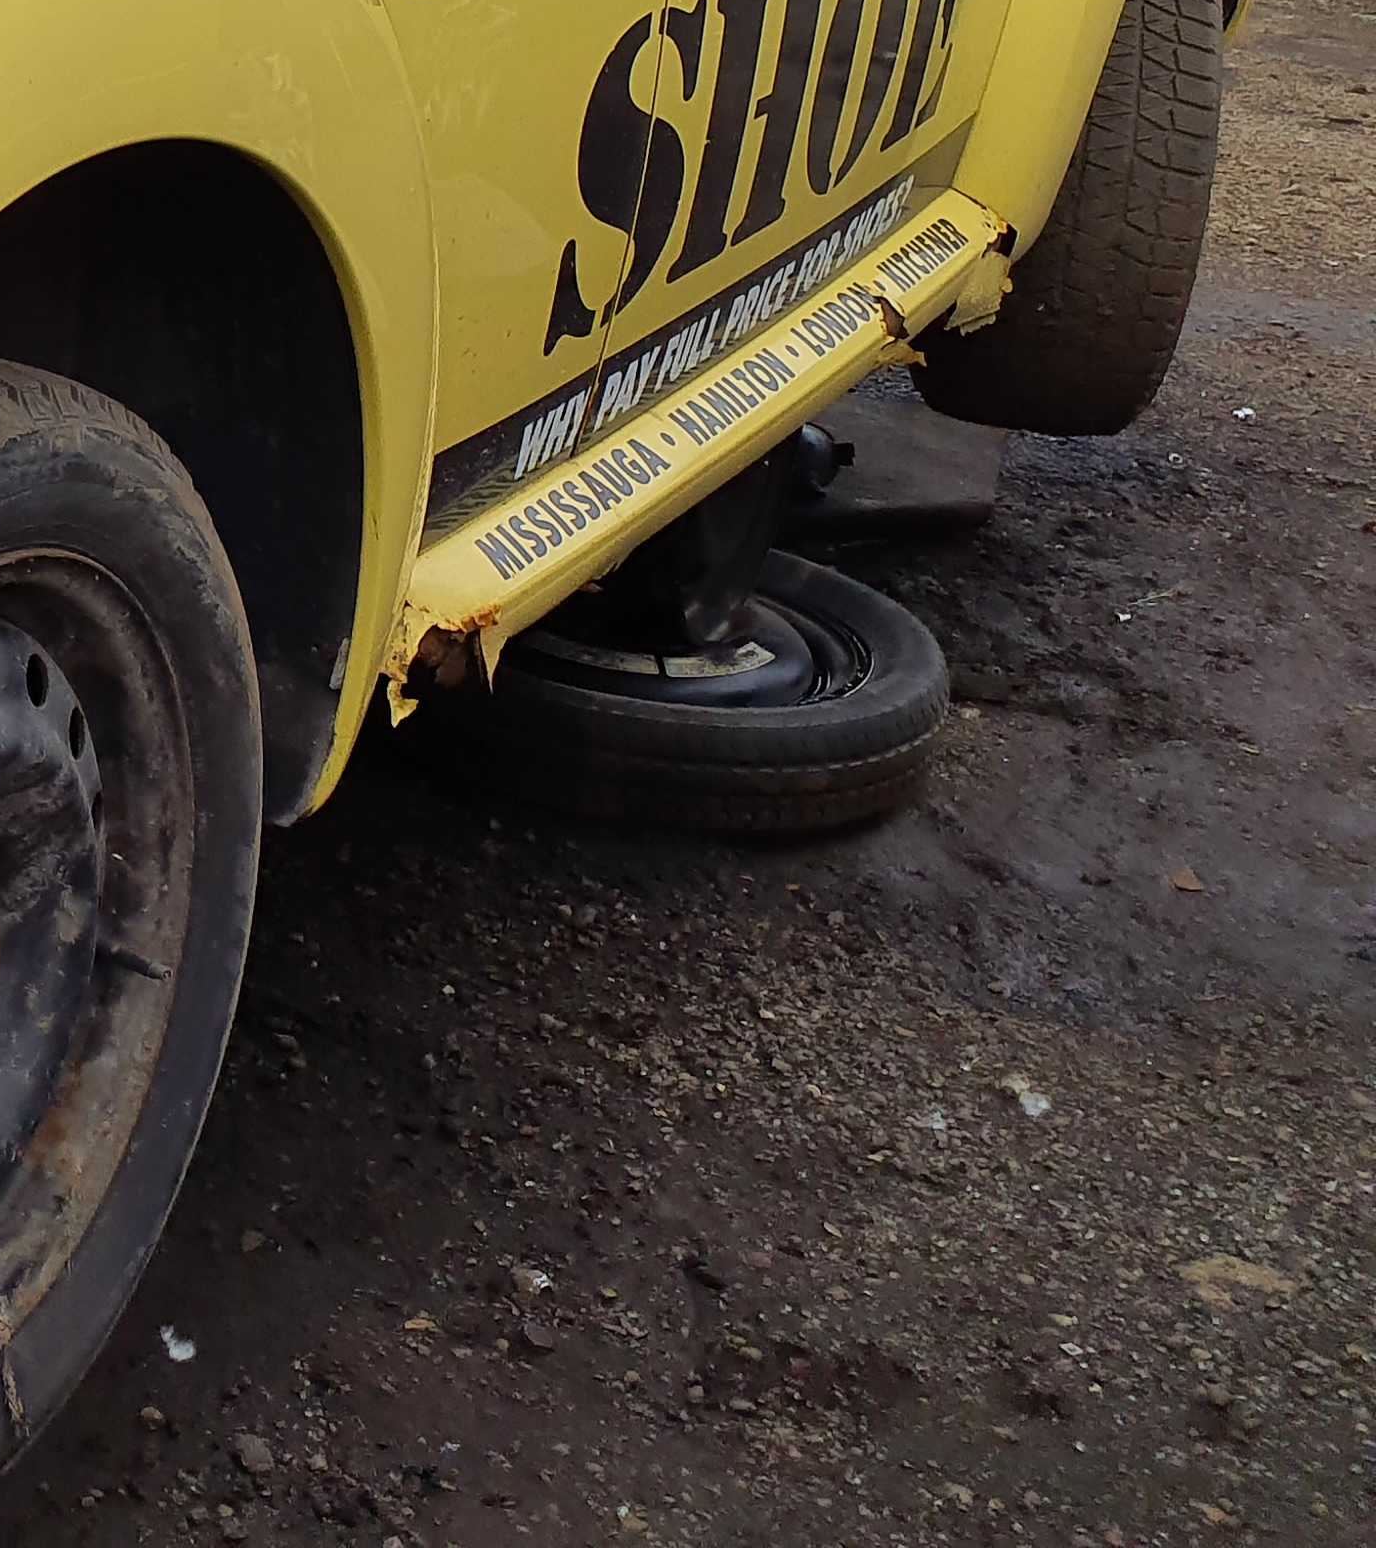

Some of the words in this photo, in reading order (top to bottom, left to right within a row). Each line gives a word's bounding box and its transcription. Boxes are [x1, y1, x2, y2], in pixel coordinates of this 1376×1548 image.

[474, 437, 672, 582] MISSISSAUGA
[667, 346, 795, 447] HAMILTON
[790, 281, 880, 358] LONDON
[876, 218, 970, 293] KITCHENER
[514, 385, 592, 481] WHY
[593, 345, 661, 433] PAY
[654, 307, 721, 394] FULL
[720, 260, 797, 351] PRICE
[791, 230, 842, 302] FOR
[837, 174, 915, 269] SHOES?
